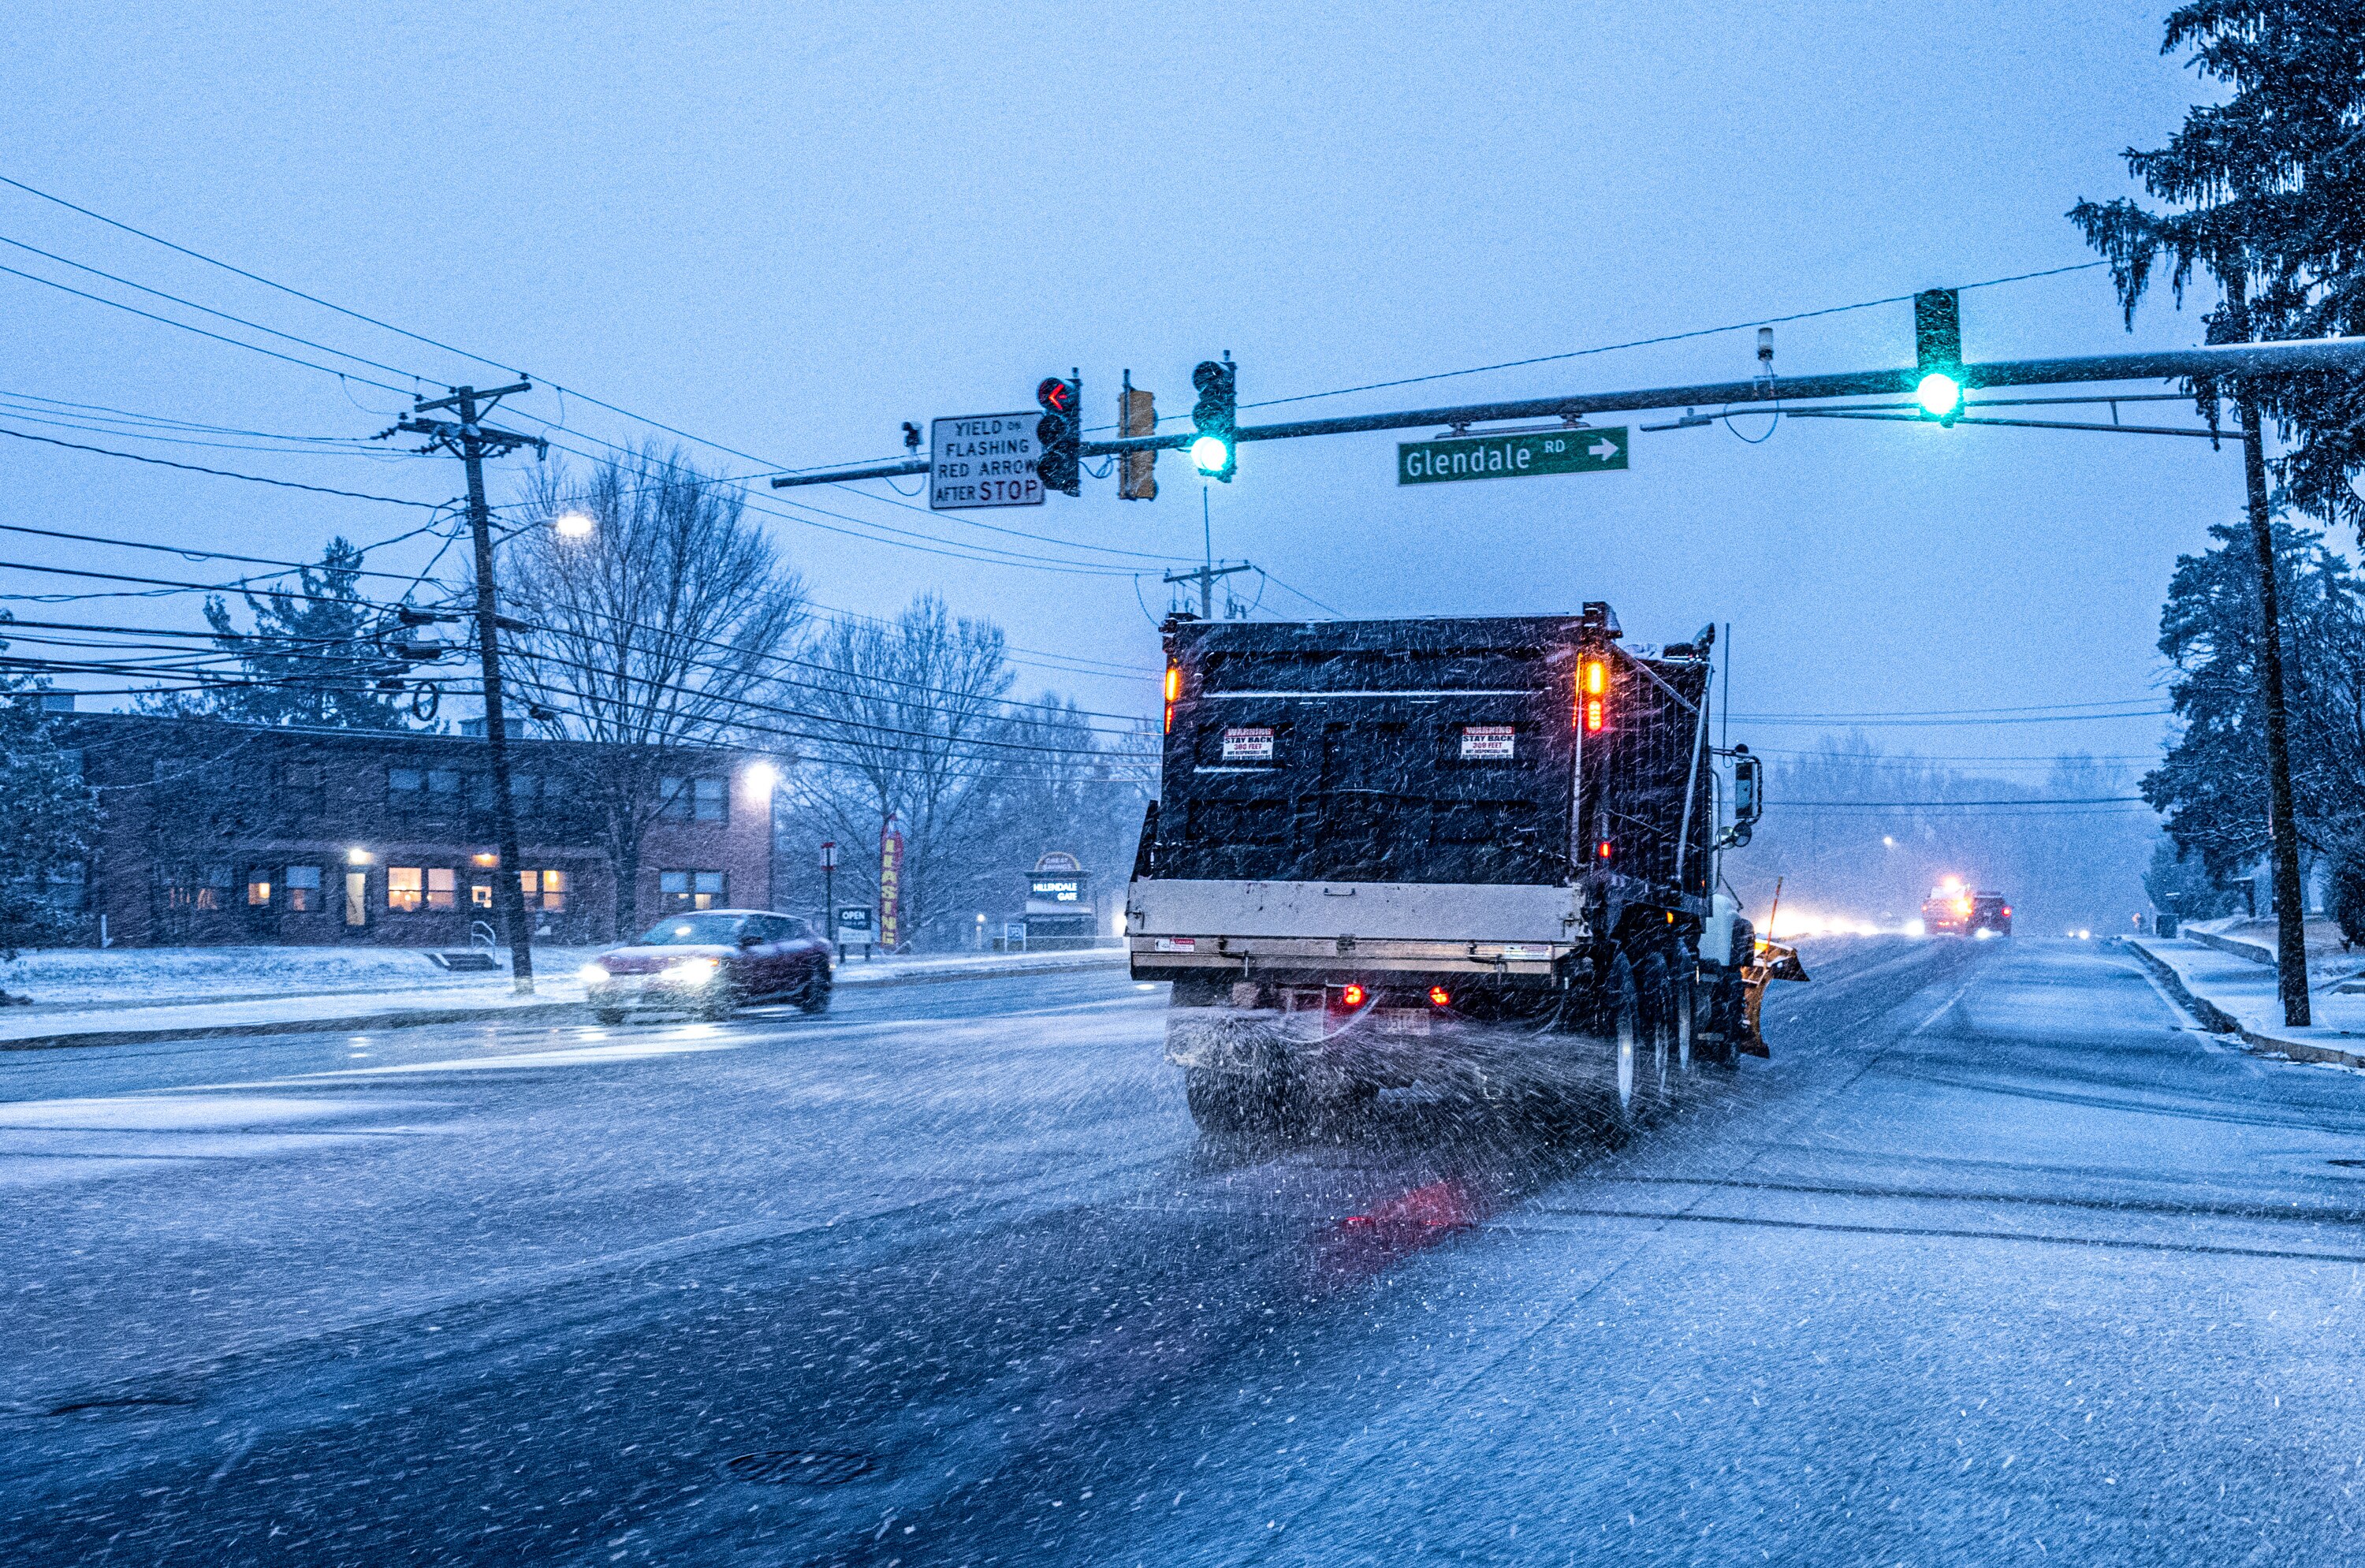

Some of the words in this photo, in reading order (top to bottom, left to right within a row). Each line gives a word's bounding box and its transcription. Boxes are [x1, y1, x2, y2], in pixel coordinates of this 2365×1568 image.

[955, 420, 1002, 436] YIELD
[1007, 421, 1022, 431] ON
[947, 439, 1029, 457] FLASHING
[1406, 444, 1531, 477] Glendale
[1544, 440, 1566, 454] RD
[938, 462, 970, 479] RED
[979, 460, 1037, 475] ARROW
[936, 486, 975, 501] AFTER
[980, 480, 1037, 501] STOP
[1033, 883, 1078, 892] HILLENDALE
[1057, 892, 1078, 901] GATE
[842, 911, 865, 920] OPEN
